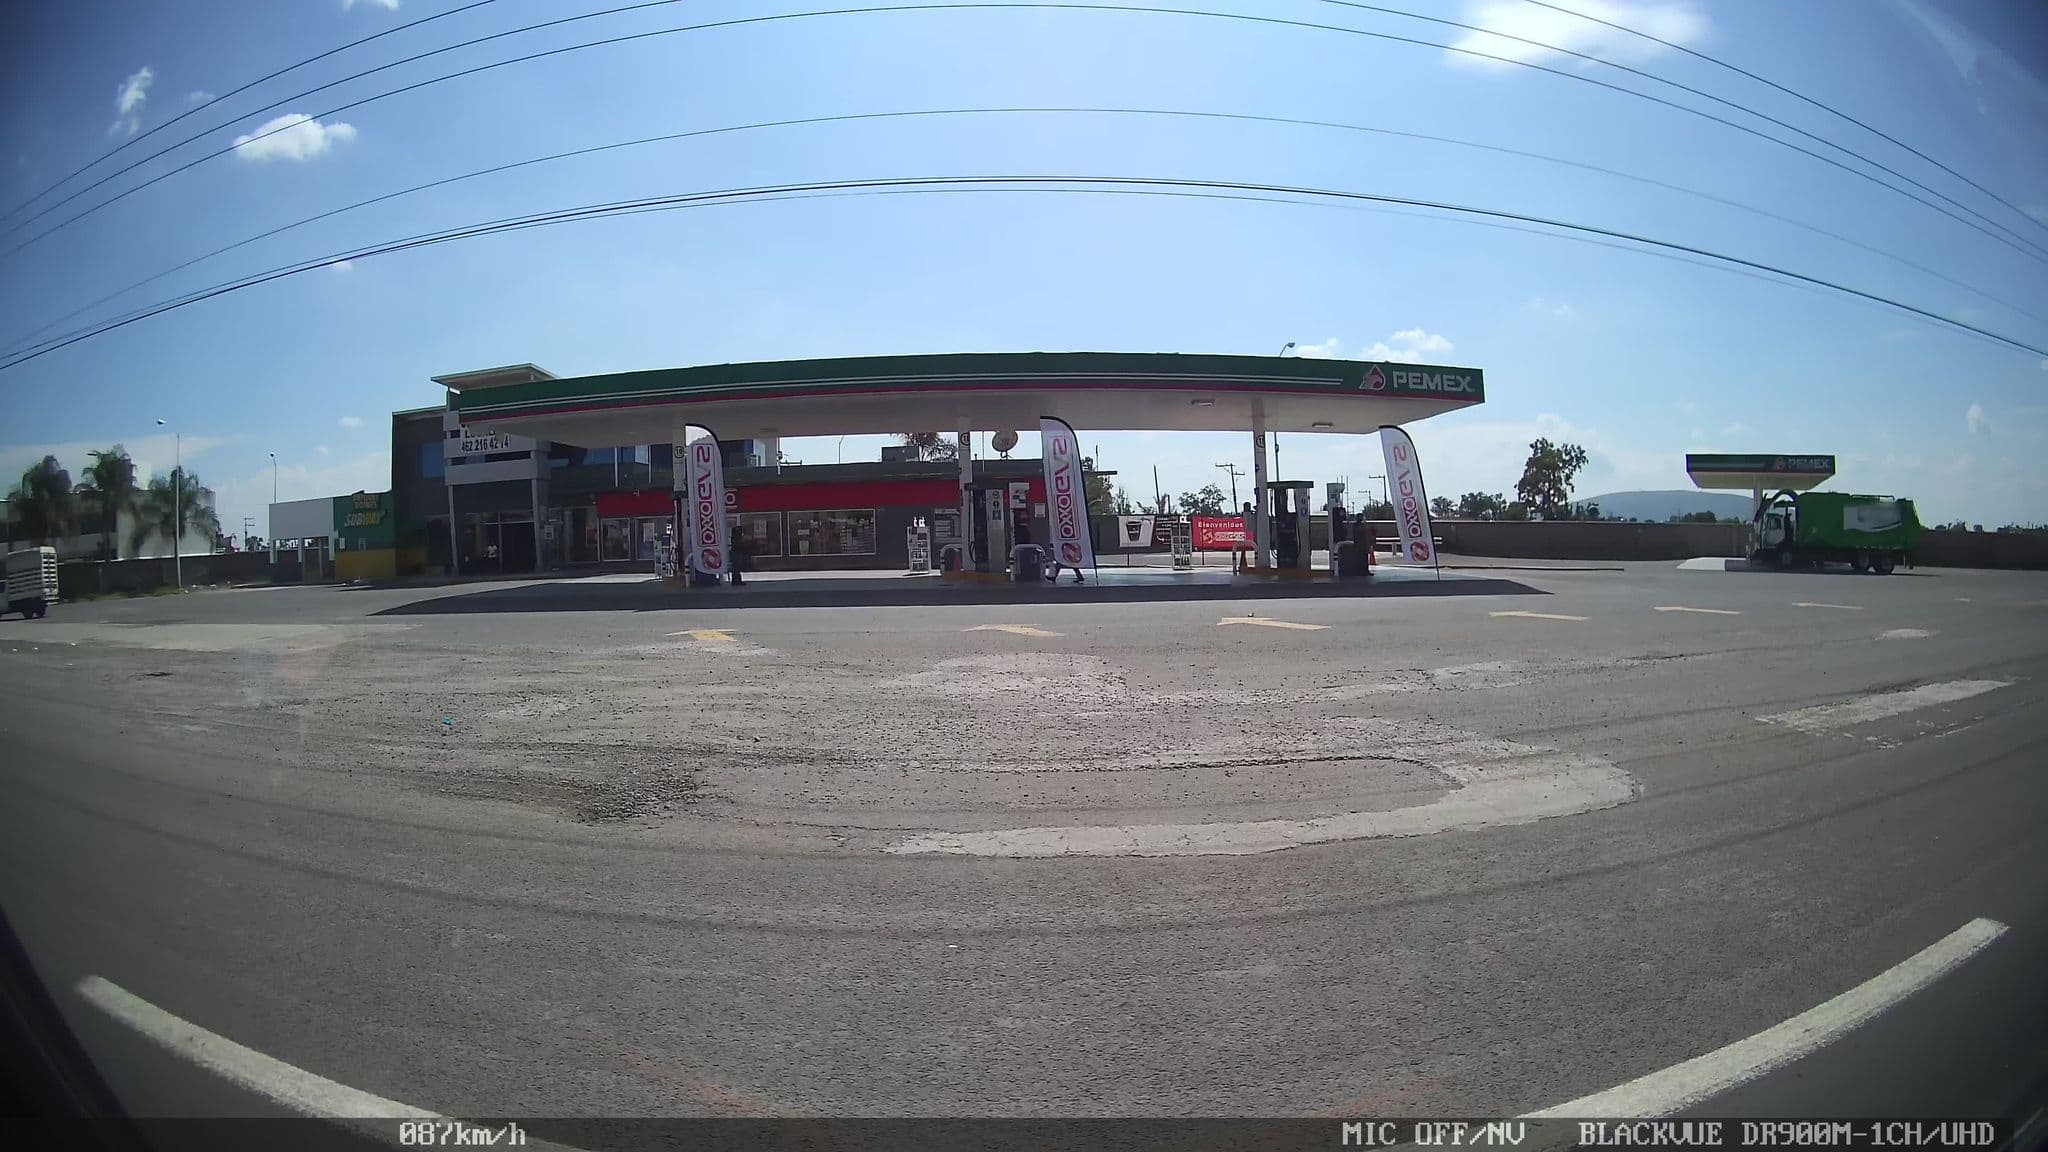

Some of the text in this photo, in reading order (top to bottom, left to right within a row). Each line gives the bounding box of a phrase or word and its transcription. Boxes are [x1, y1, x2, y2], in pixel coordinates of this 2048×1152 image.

[1392, 370, 1472, 393] PEMEX
[474, 439, 488, 451] 216
[1788, 458, 1831, 469] PEMEX
[344, 511, 384, 527] SUBWAY
[699, 500, 716, 545] OXXO
[1056, 493, 1075, 539] OXXO
[1402, 496, 1422, 539] OXXO
